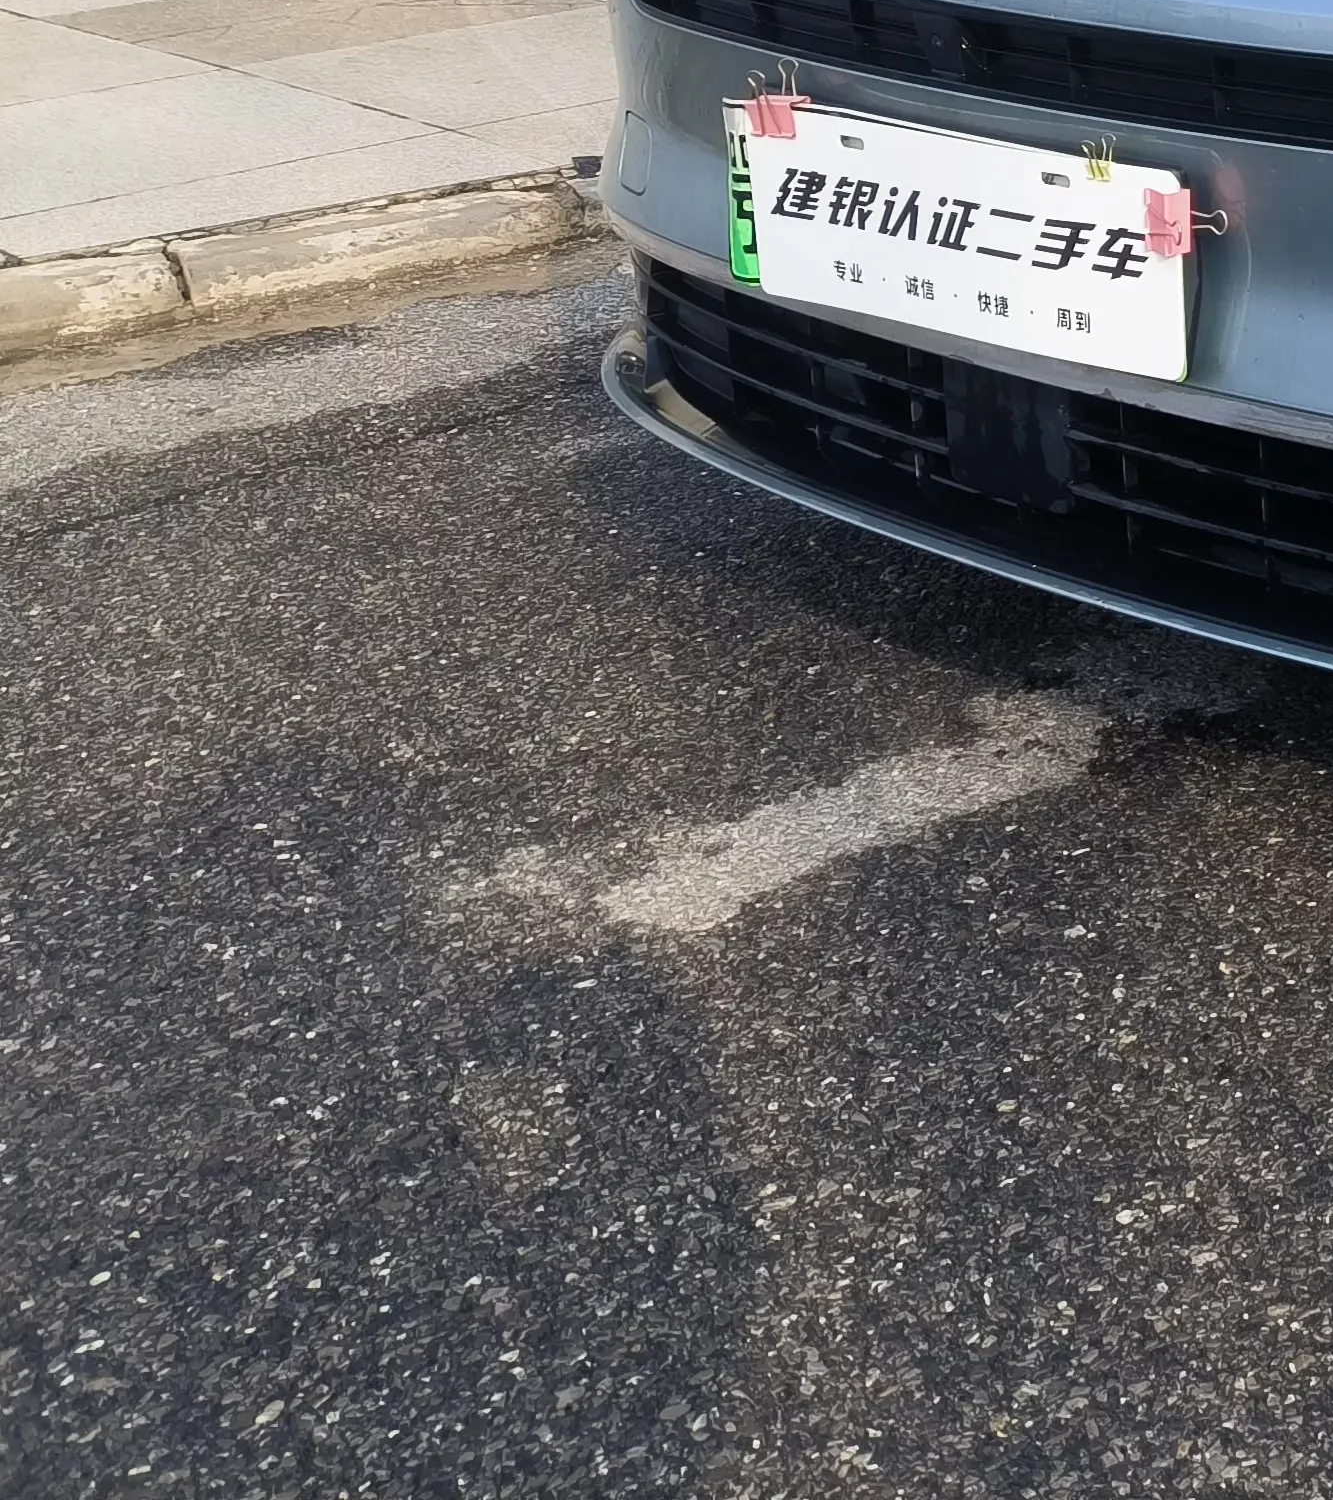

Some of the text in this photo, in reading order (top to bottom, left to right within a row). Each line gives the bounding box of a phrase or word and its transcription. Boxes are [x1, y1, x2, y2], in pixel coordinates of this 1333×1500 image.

[770, 167, 1150, 280] 建银认证二手车
[833, 259, 1091, 334] 专业 诚信 快捷 周到
